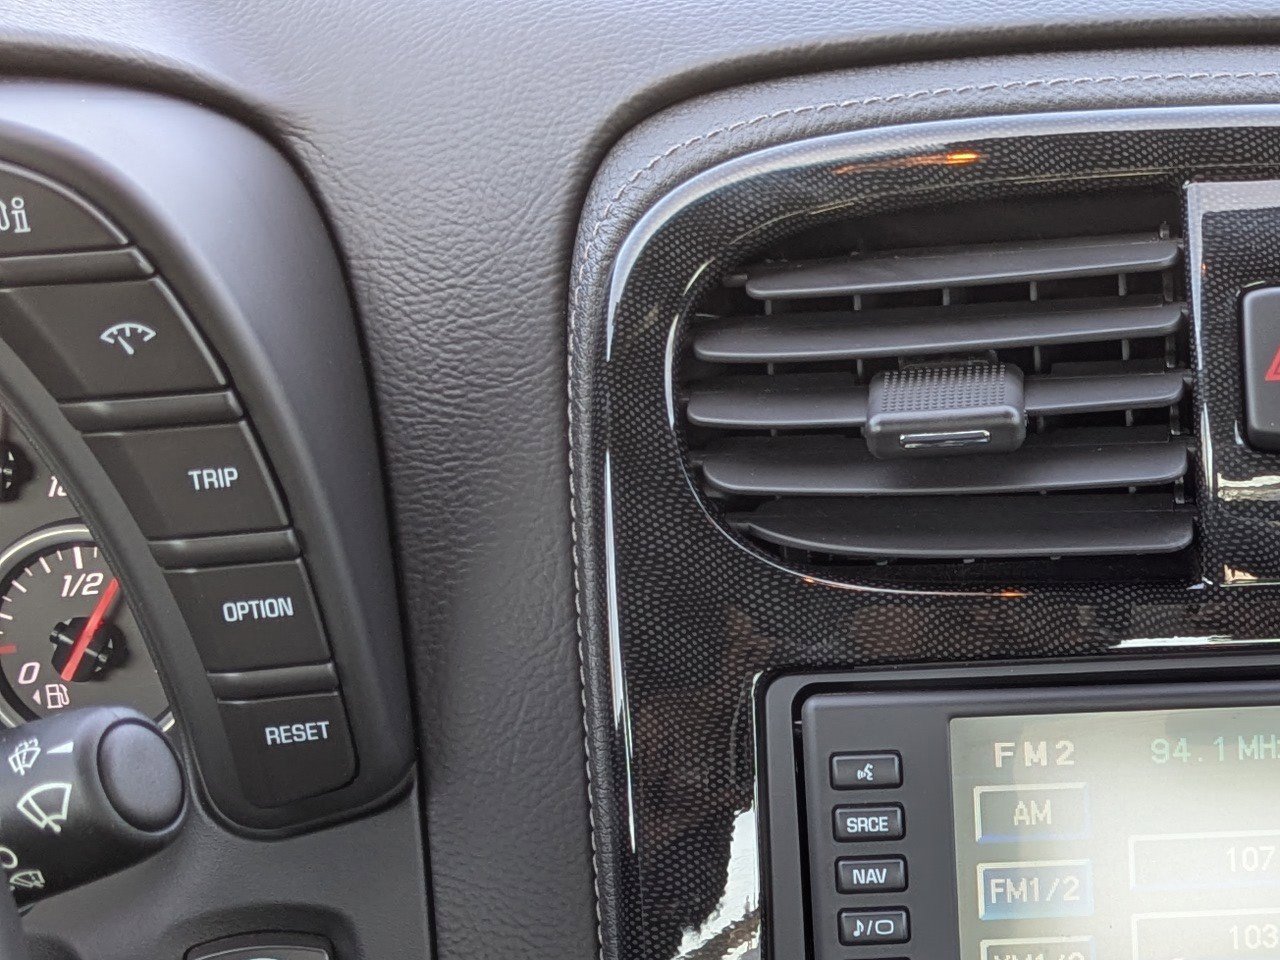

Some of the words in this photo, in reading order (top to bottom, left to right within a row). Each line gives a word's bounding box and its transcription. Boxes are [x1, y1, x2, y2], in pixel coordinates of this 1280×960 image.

[188, 467, 239, 491] TRIP
[61, 572, 104, 598] 1/2
[222, 597, 294, 622] OPTION
[18, 662, 40, 684] 0
[265, 721, 330, 746] RESET
[1150, 736, 1226, 763] 94.1
[846, 816, 889, 833] SRCE
[1013, 800, 1052, 826] AM
[852, 868, 887, 884] NAV
[990, 875, 1081, 904] FM1/2
